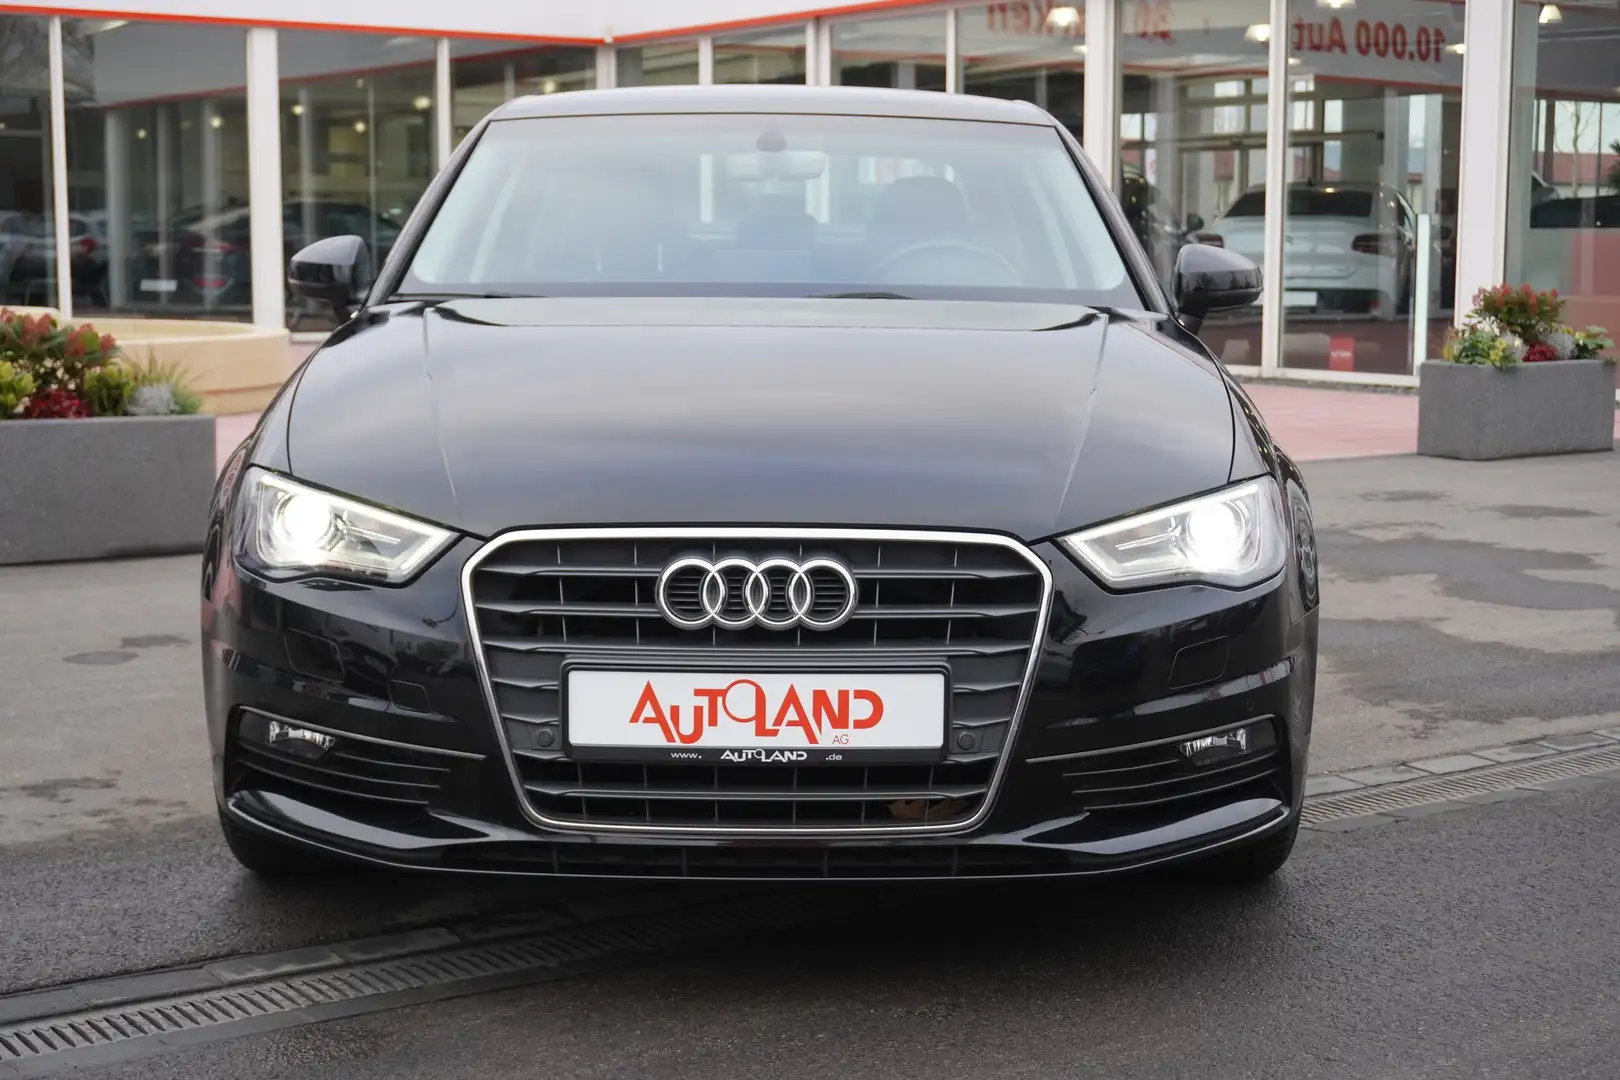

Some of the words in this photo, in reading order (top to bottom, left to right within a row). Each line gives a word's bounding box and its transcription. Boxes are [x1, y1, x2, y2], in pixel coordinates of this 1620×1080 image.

[629, 678, 885, 745] AUTOLAND
[832, 733, 850, 745] AG
[670, 751, 702, 760] www.
[720, 748, 808, 763] AUTOLAND
[825, 752, 843, 761] .de
